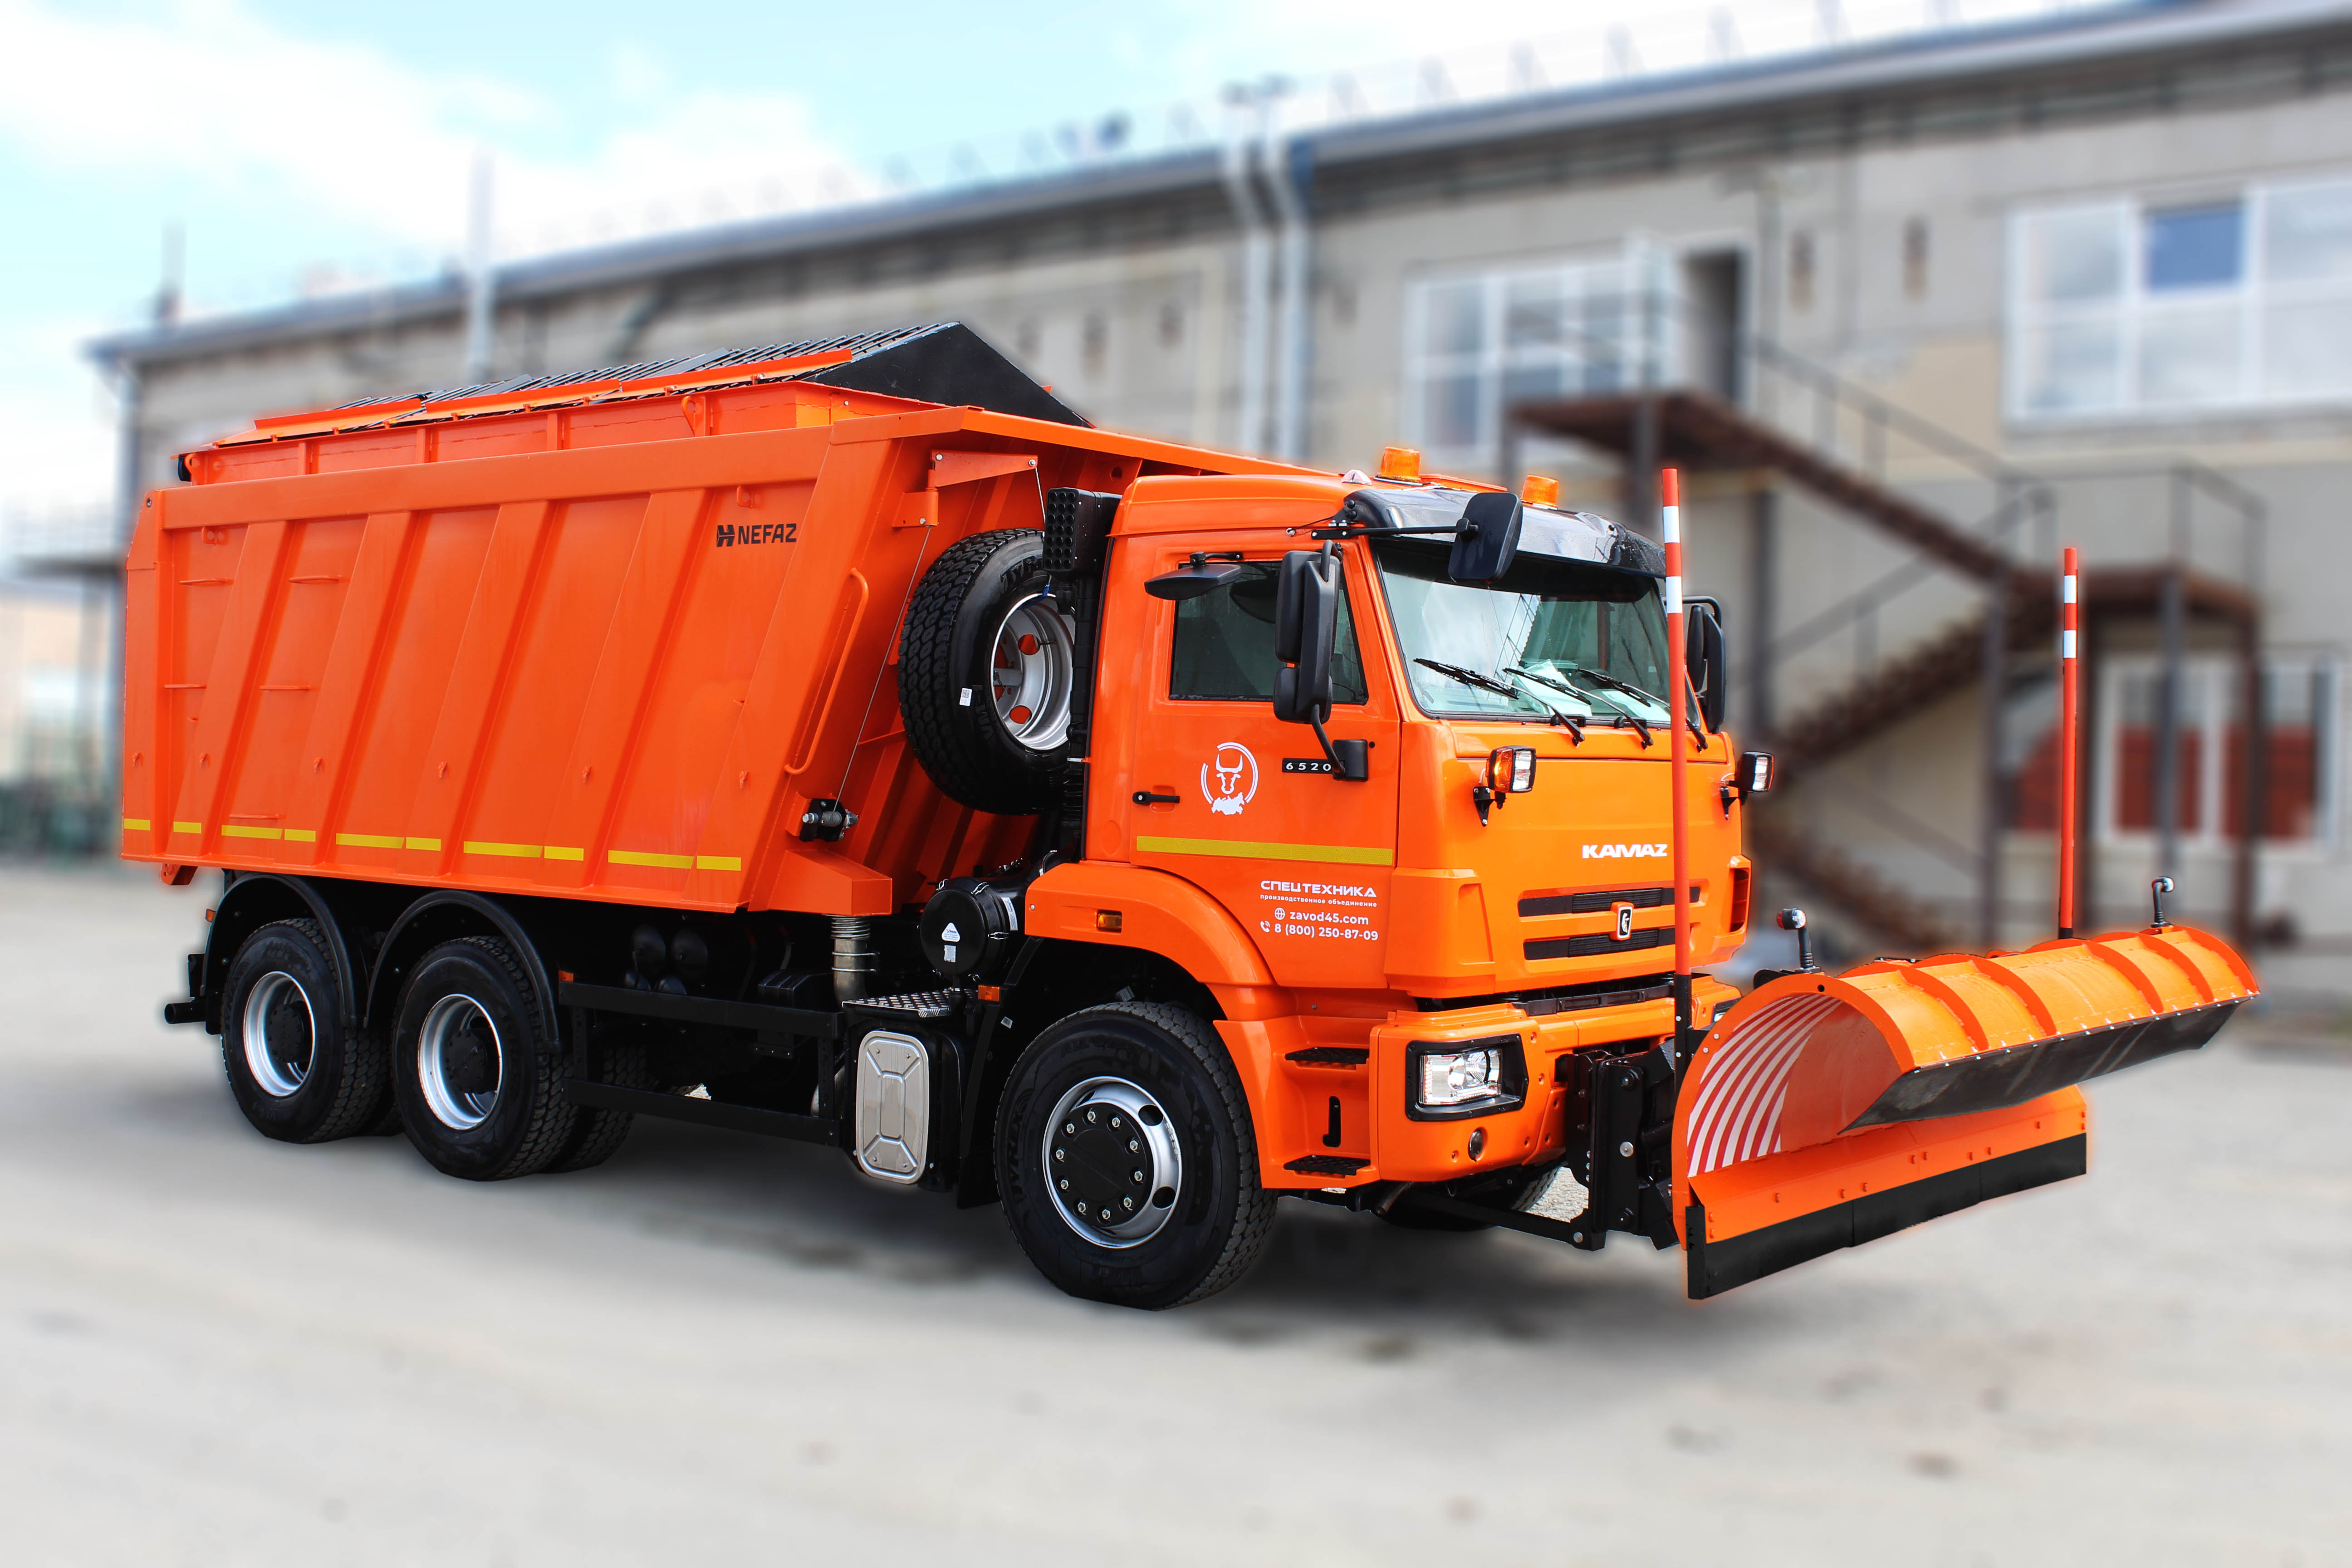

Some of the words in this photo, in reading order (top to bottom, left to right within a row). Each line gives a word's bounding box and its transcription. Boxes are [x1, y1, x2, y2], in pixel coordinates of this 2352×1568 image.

[738, 523, 797, 544] NEFAZ
[1286, 762, 1331, 771] 6520
[1582, 843, 1668, 859] KAMAZ
[1260, 880, 1377, 897] СПЕЦТЕХНИКА
[1260, 894, 1326, 904] производственное
[1328, 898, 1377, 907] объединение
[1289, 911, 1369, 925] zavod45.com
[1274, 923, 1282, 933] 8
[1285, 923, 1315, 938] (800)
[1318, 926, 1378, 941] 250-87-09
